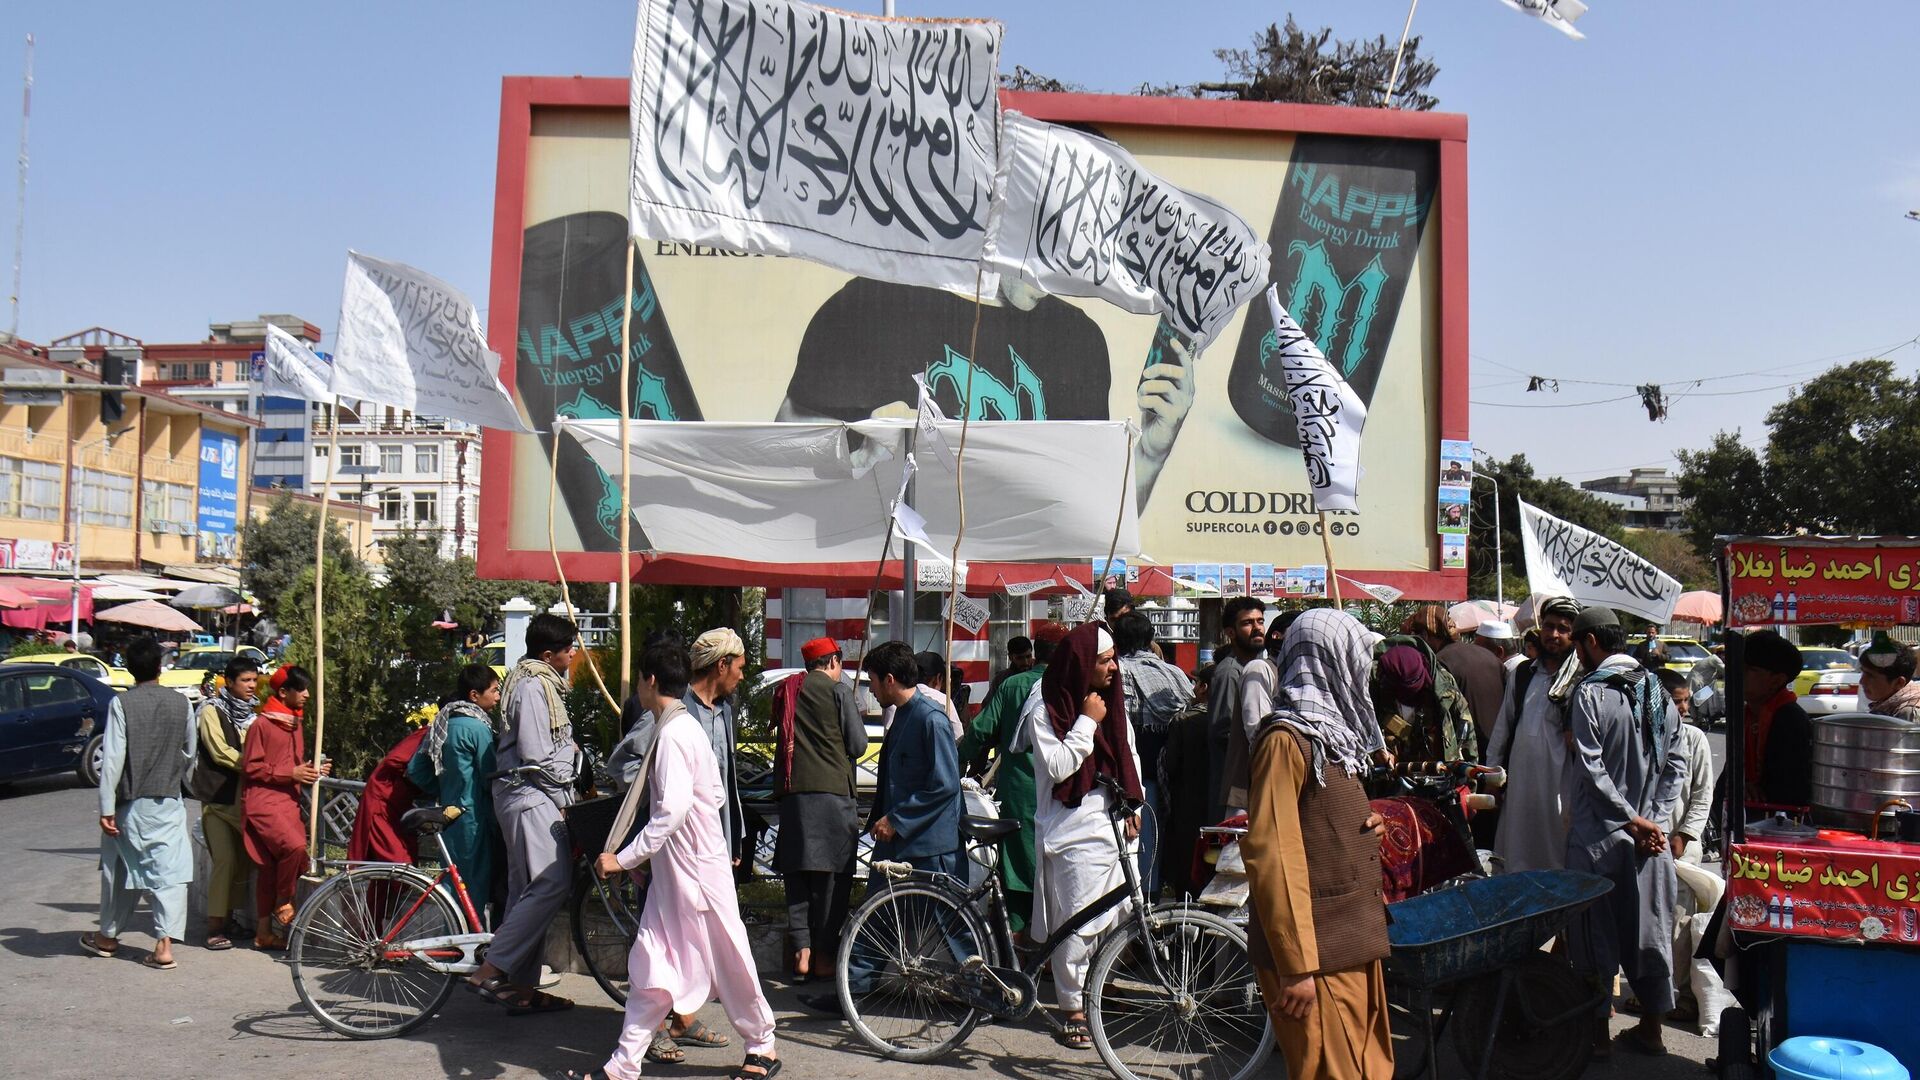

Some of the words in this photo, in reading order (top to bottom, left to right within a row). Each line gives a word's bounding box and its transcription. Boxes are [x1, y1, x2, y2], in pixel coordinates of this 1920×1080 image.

[1291, 157, 1429, 229] HAPPY
[1299, 202, 1352, 246] Energy
[1354, 229, 1400, 249] Drink
[517, 269, 656, 365] HAPPY
[539, 359, 604, 386] Energy
[605, 332, 653, 374] Dink
[1185, 490, 1265, 514] COLD
[1186, 521, 1260, 534] SUPERCOLA
[1822, 554, 1881, 580] احمد
[1819, 862, 1879, 889] احمد
